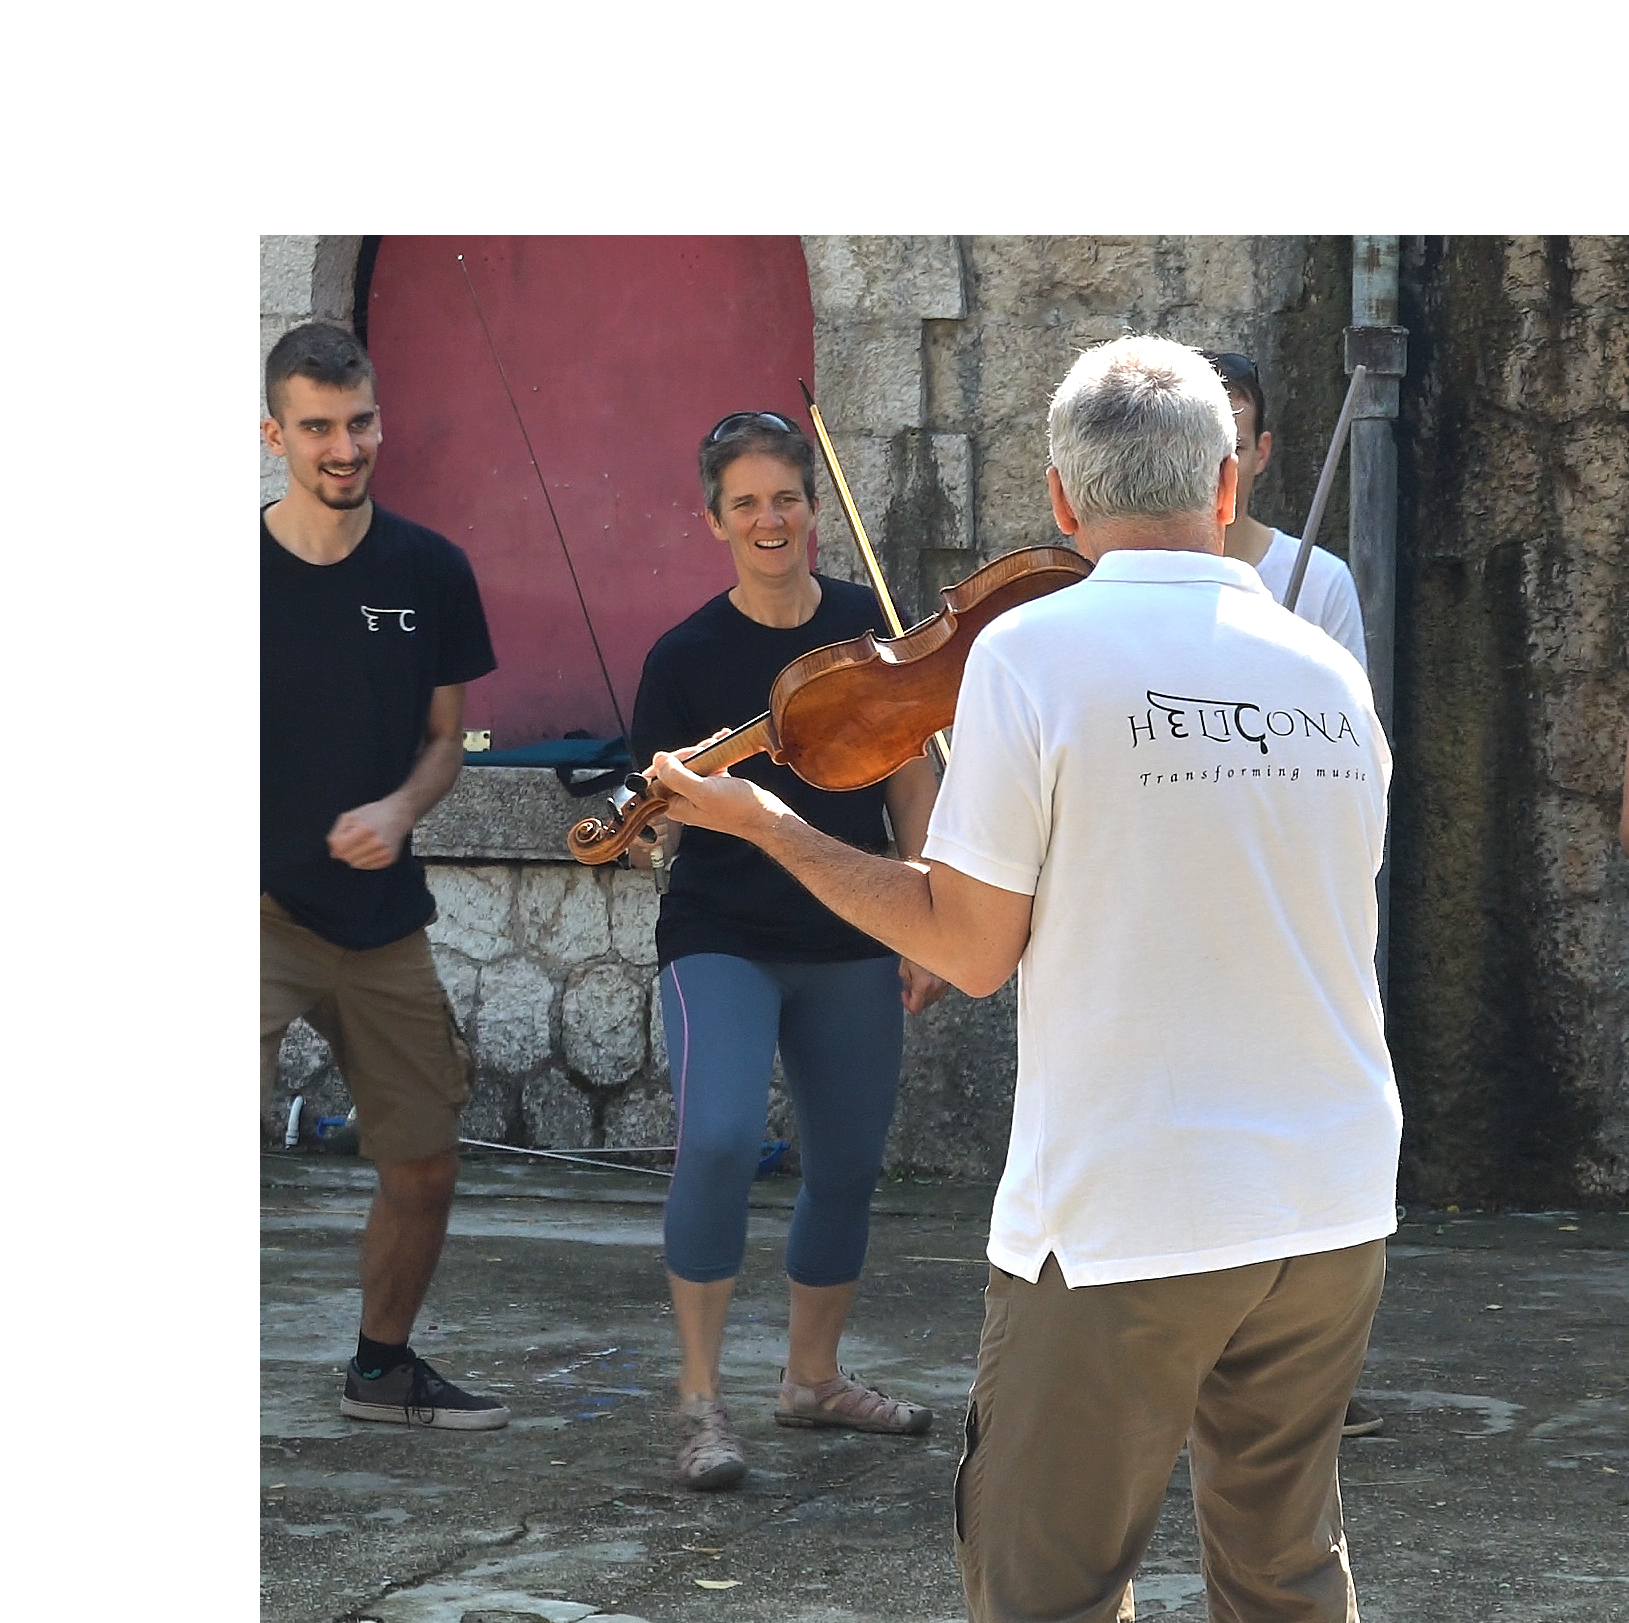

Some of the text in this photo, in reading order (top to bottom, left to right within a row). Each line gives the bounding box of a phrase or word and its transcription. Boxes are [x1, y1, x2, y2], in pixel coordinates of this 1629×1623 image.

[1127, 690, 1360, 755] HELICONA
[1140, 765, 1367, 786] Transforming music
